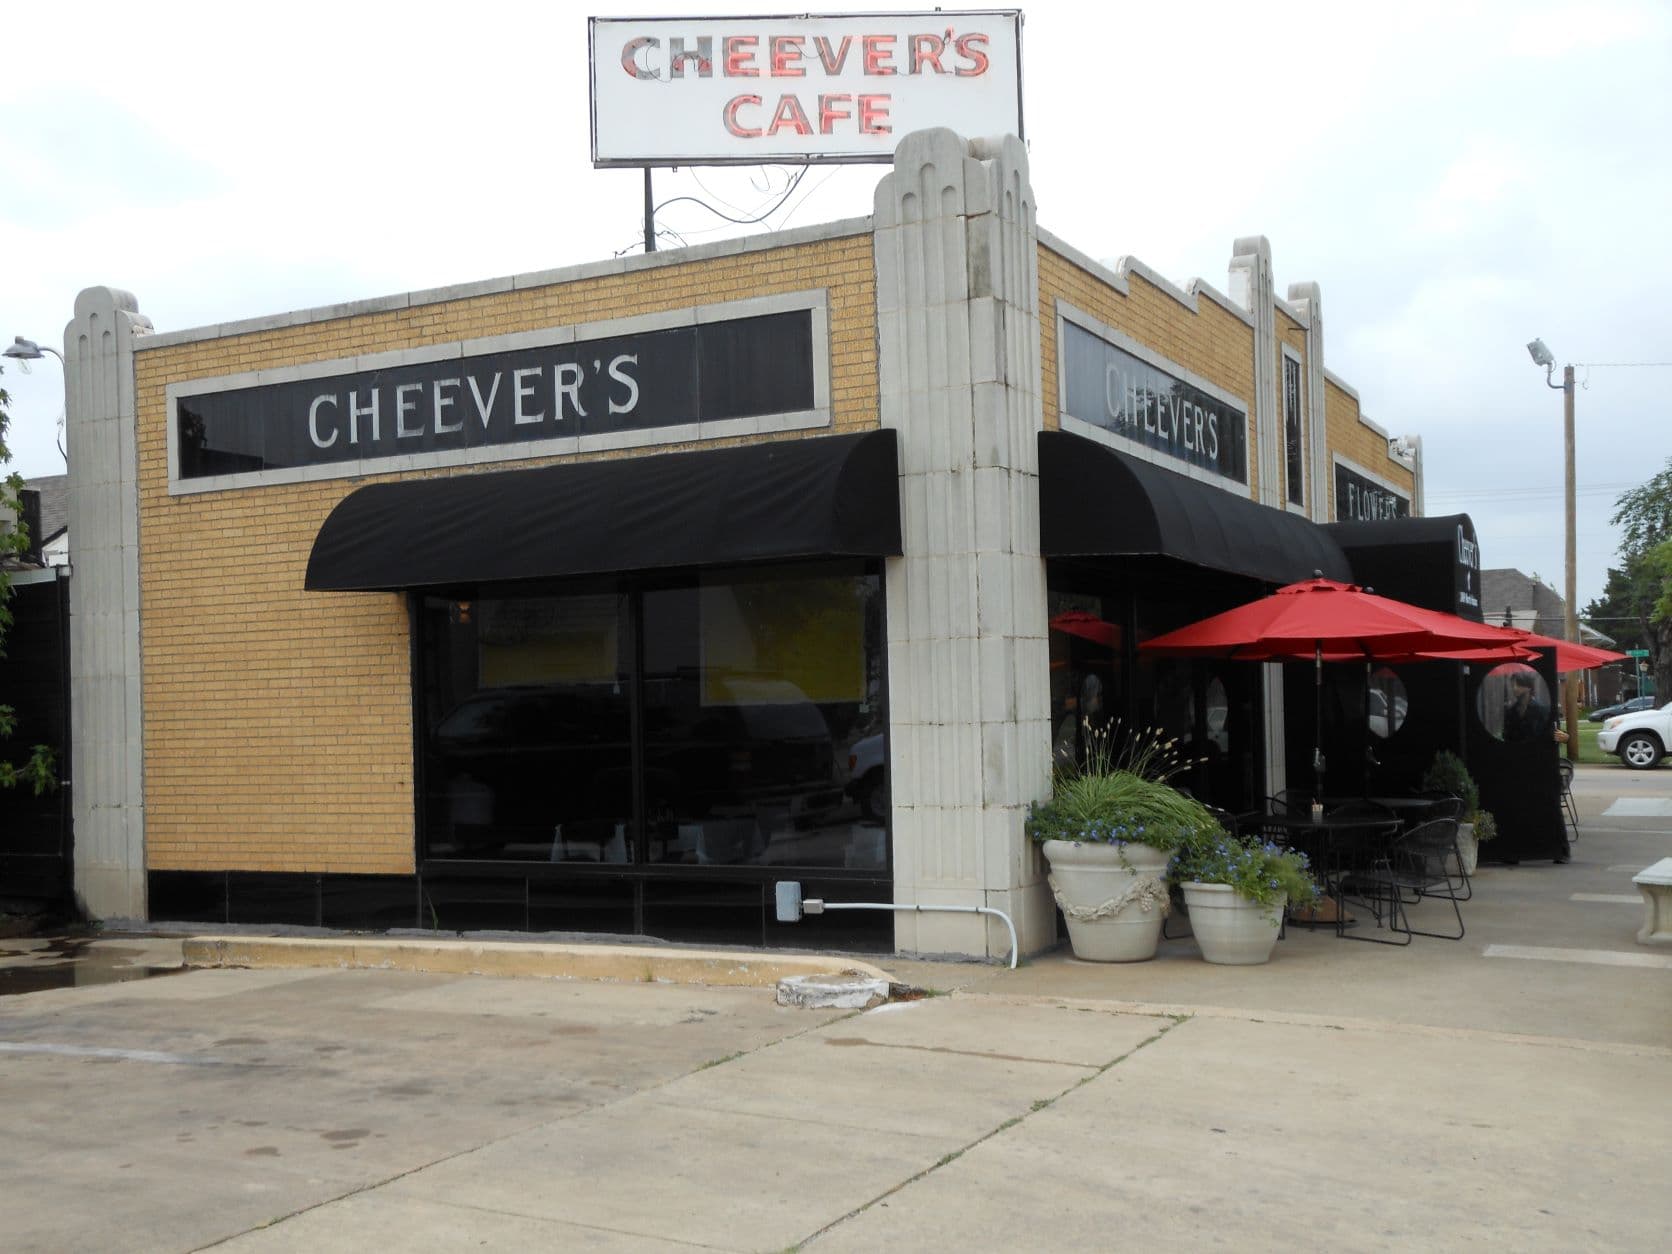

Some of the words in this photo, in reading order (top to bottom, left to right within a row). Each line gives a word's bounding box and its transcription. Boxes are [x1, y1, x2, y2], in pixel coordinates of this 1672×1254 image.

[620, 26, 990, 81] CHEEVER'S
[722, 94, 893, 138] CAFE
[308, 353, 640, 449] CHEEVER'S
[1106, 362, 1218, 460] CHEEVER'S
